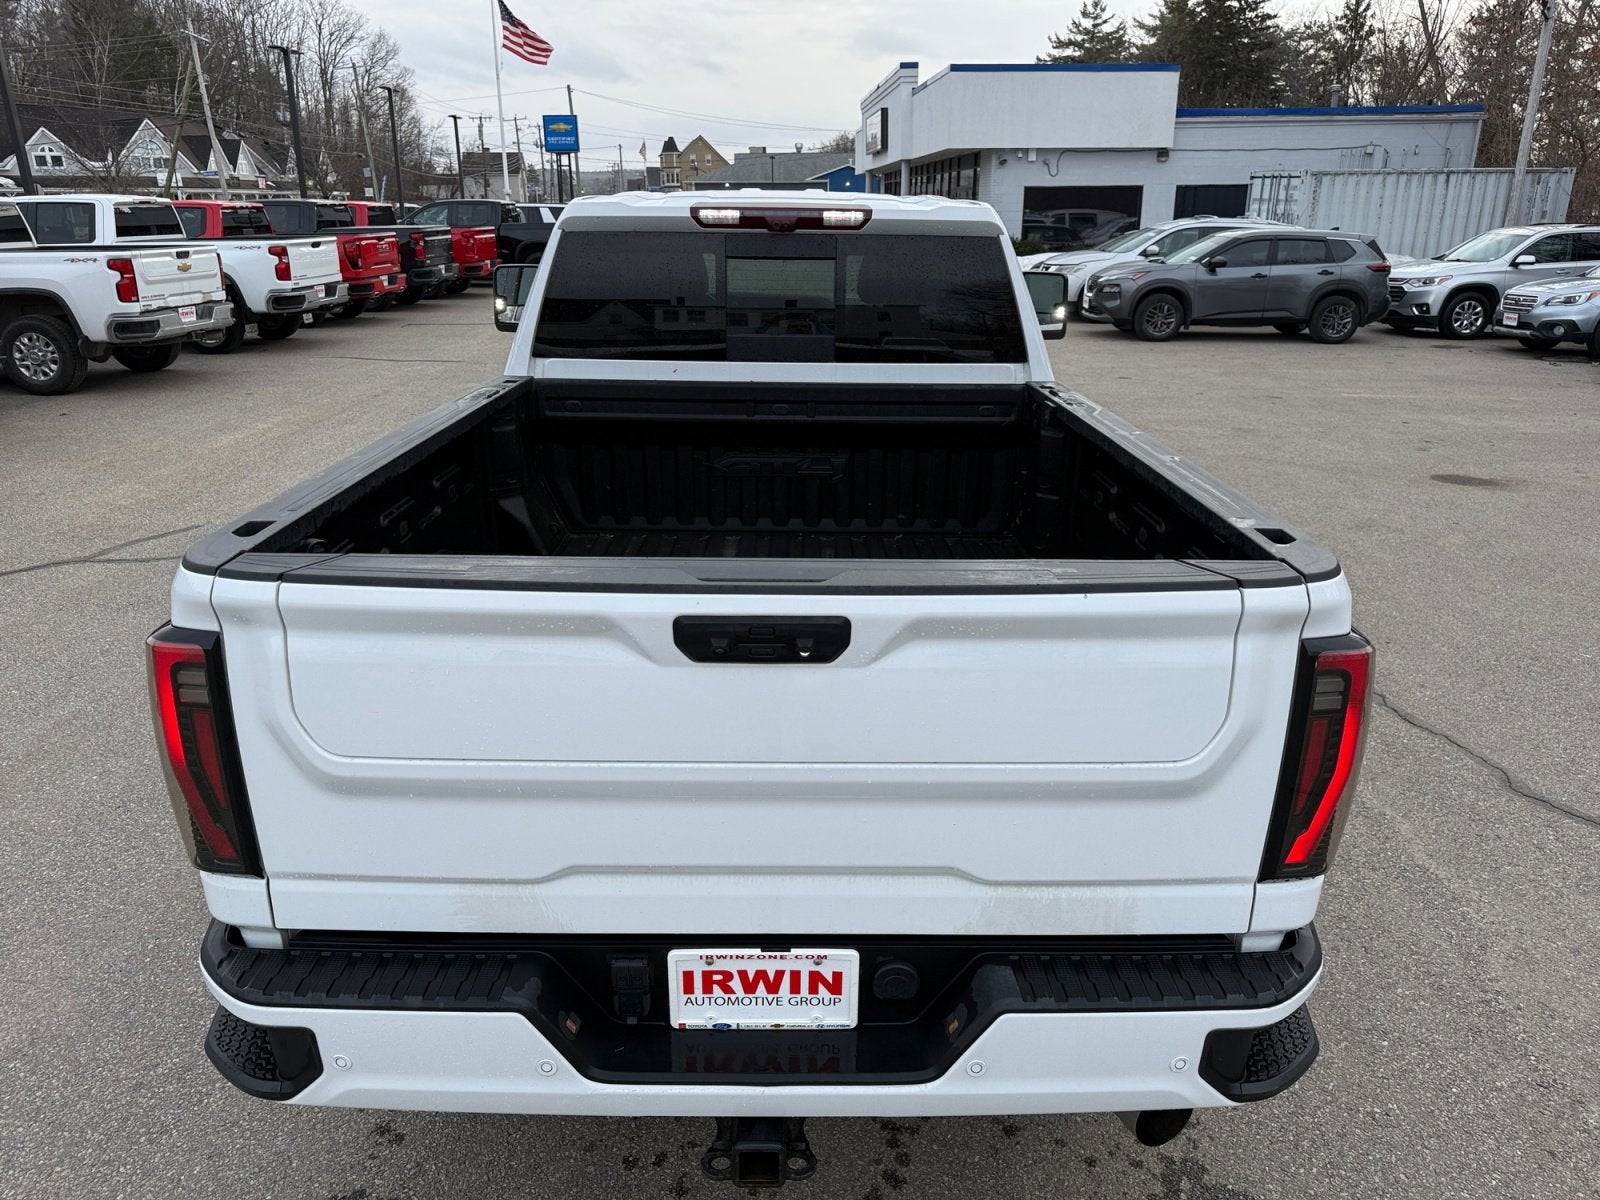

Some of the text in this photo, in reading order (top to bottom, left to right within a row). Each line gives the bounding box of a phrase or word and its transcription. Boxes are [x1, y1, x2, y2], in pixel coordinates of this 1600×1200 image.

[682, 969, 843, 996] IRWIN
[684, 996, 842, 1007] AUTOMOTIVE GROUP
